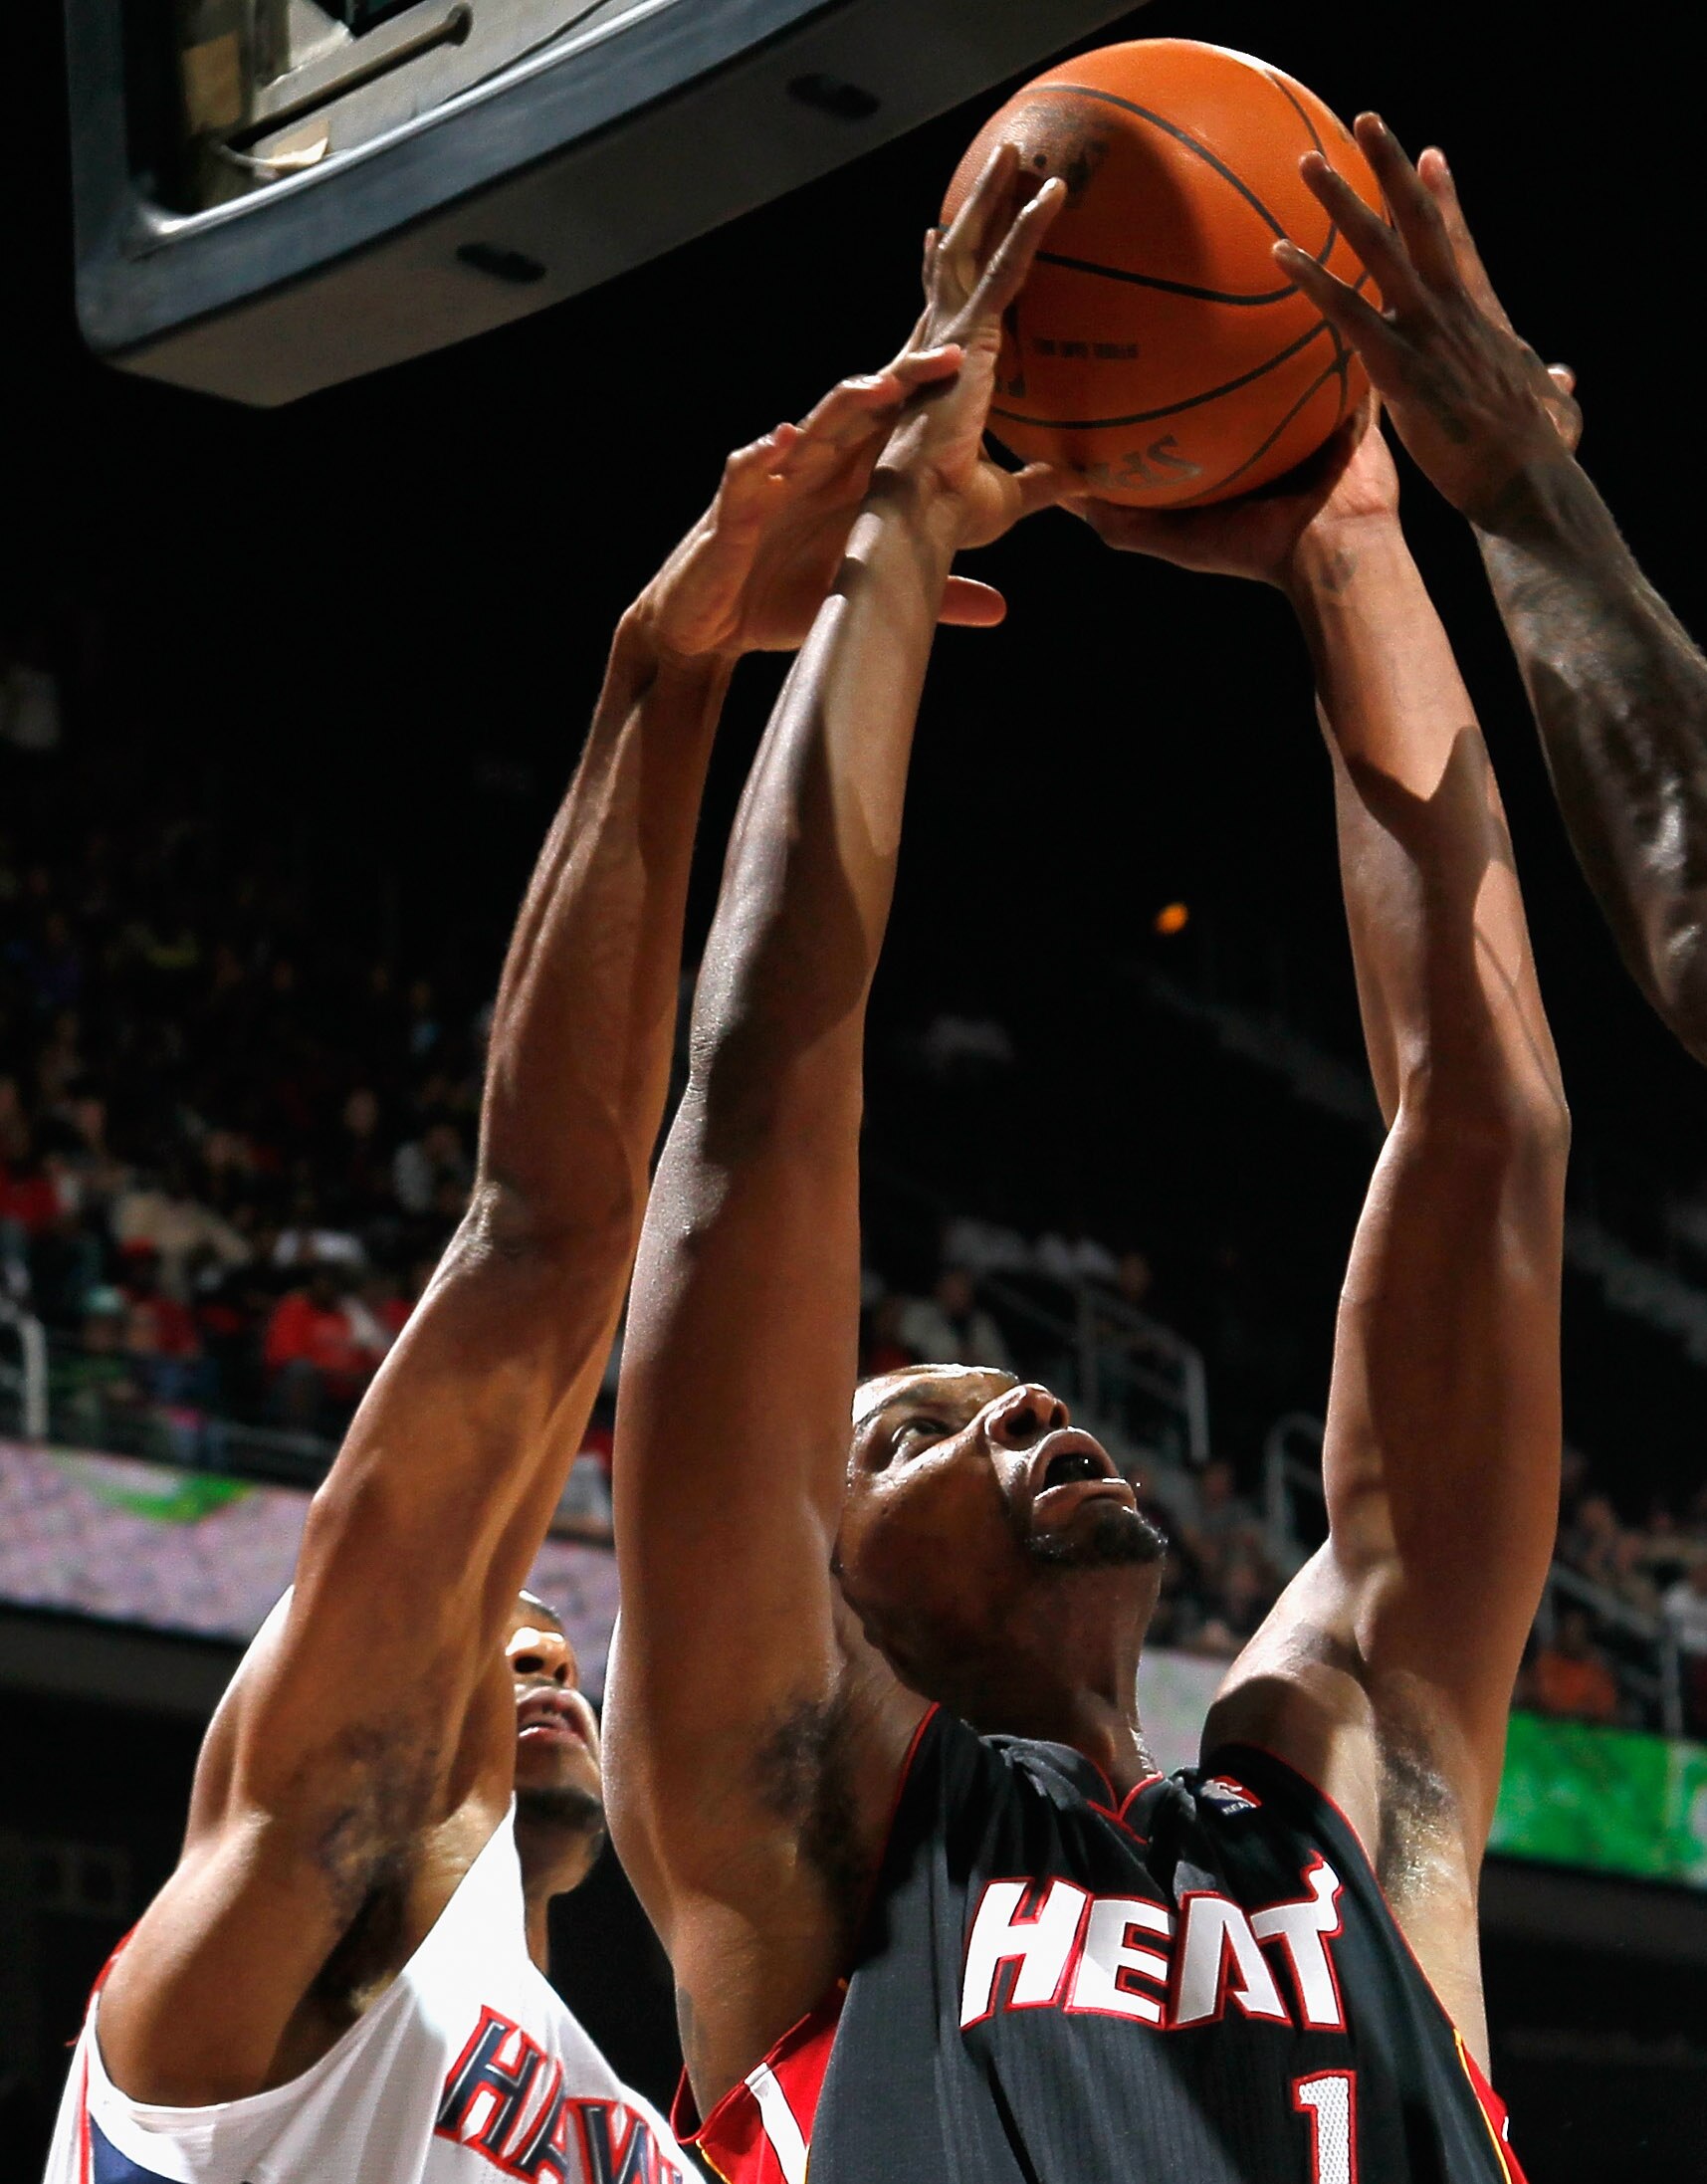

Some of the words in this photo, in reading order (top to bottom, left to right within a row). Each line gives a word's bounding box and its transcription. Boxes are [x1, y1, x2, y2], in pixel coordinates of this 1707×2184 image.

[960, 1849, 1344, 2032] HEAT
[434, 2004, 684, 2184] HAW
[1292, 2069, 1358, 2184] 1
